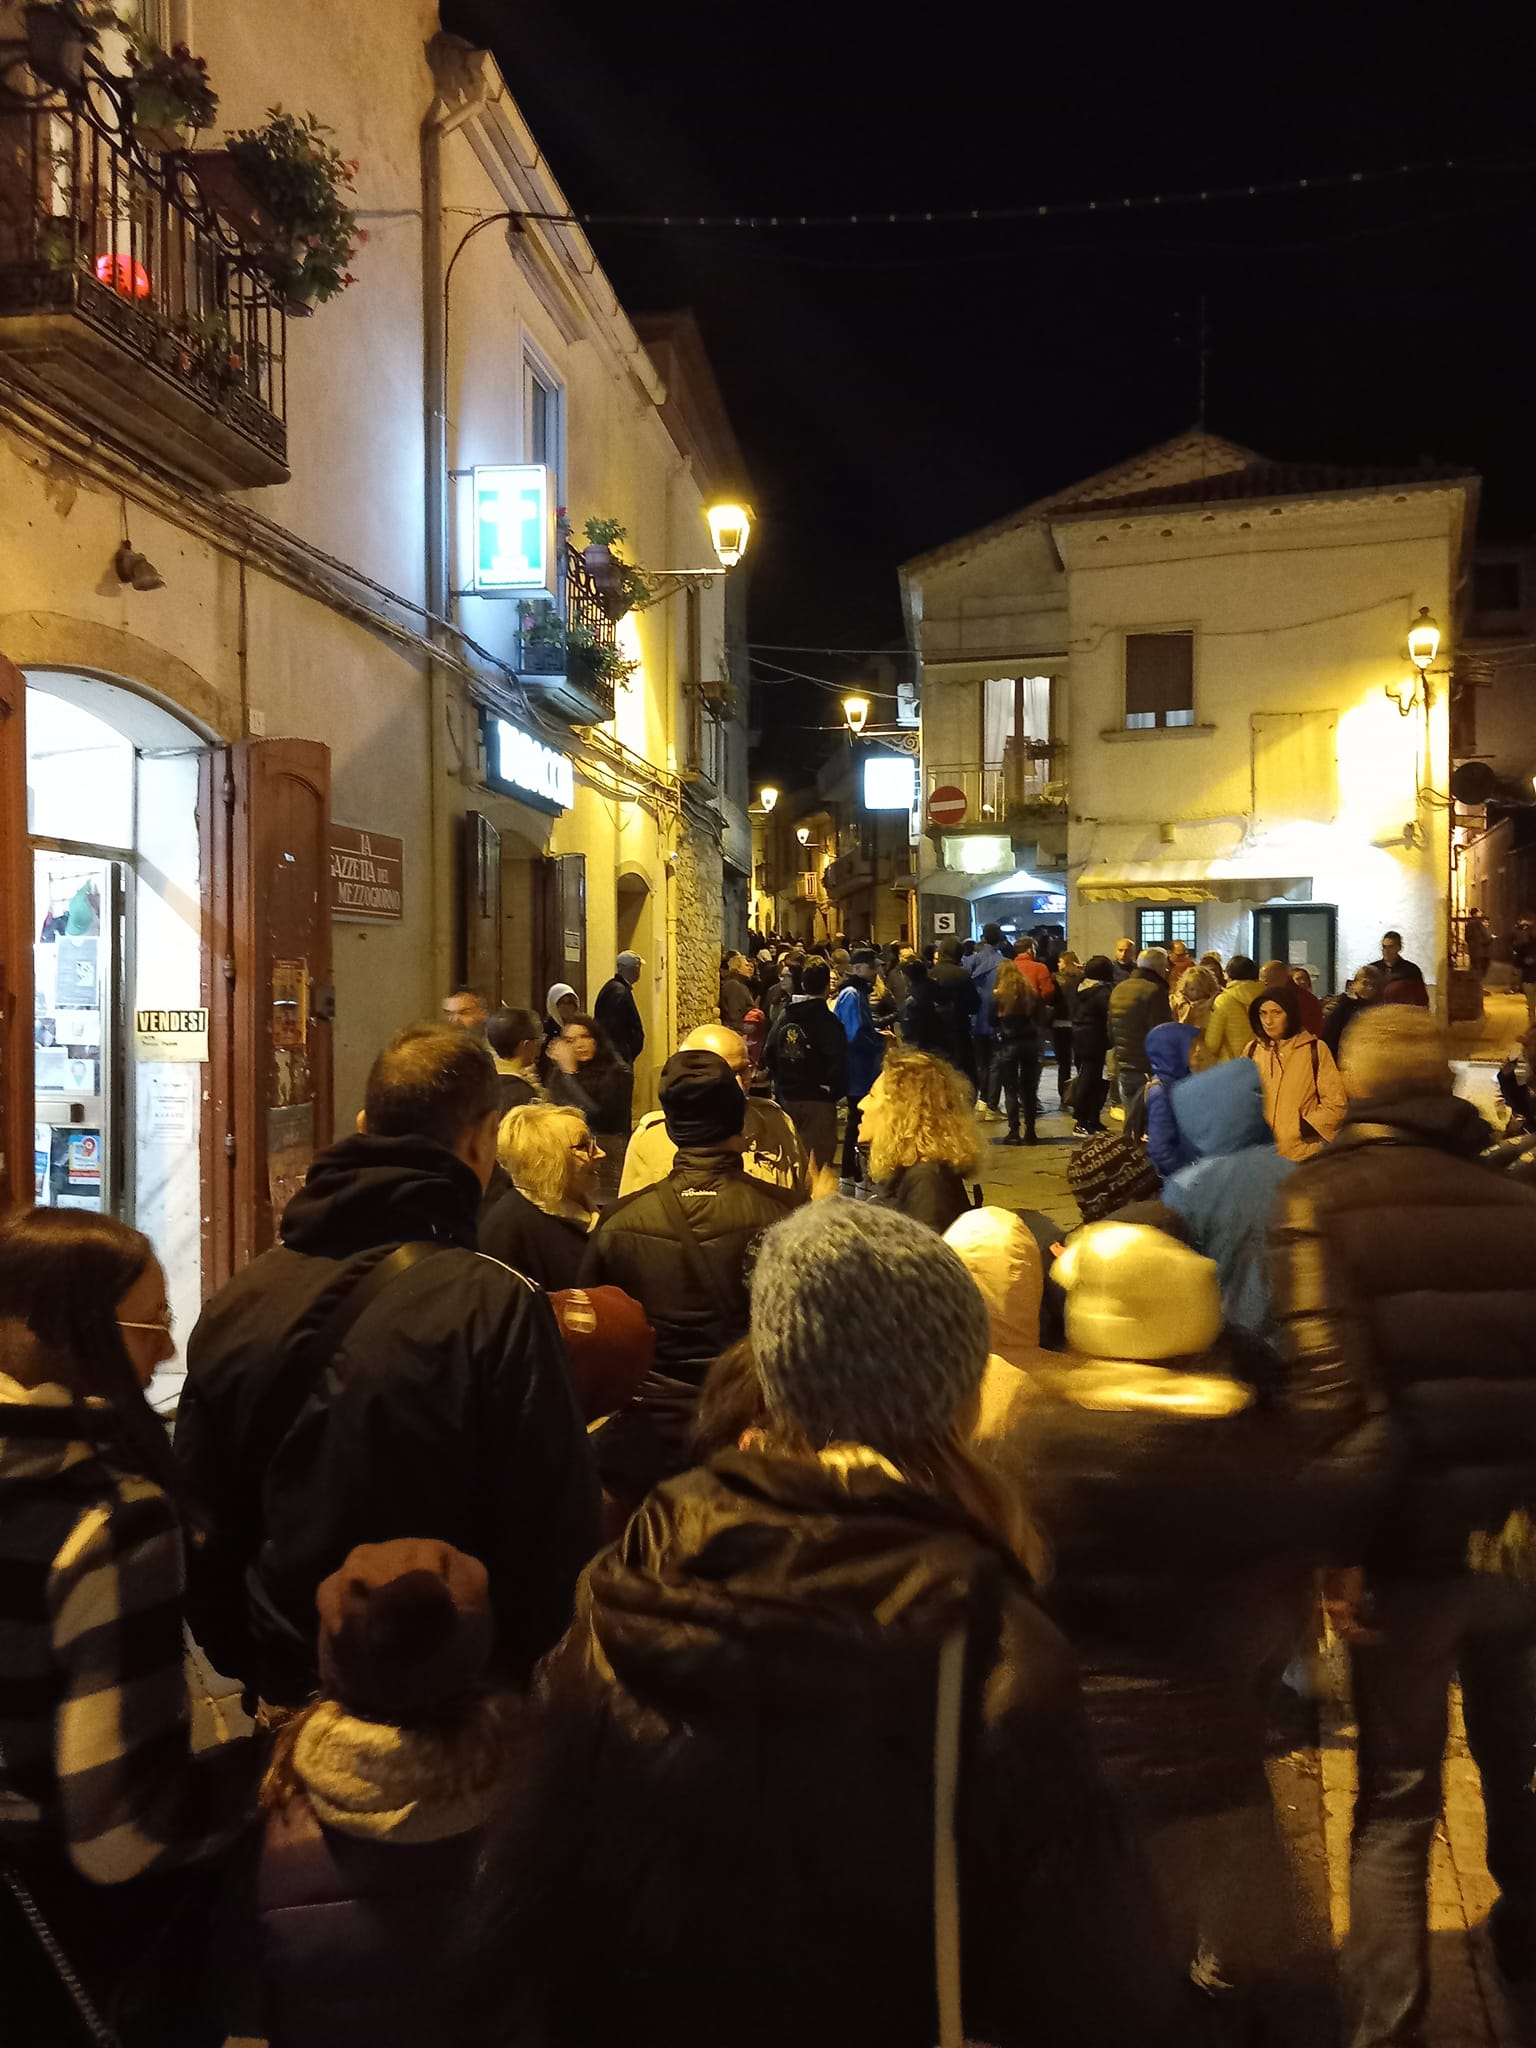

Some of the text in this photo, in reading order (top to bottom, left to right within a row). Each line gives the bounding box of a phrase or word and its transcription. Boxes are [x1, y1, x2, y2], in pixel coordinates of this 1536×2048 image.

[360, 833, 372, 855] LA
[938, 916, 950, 929] S
[138, 1011, 205, 1032] VENDESI
